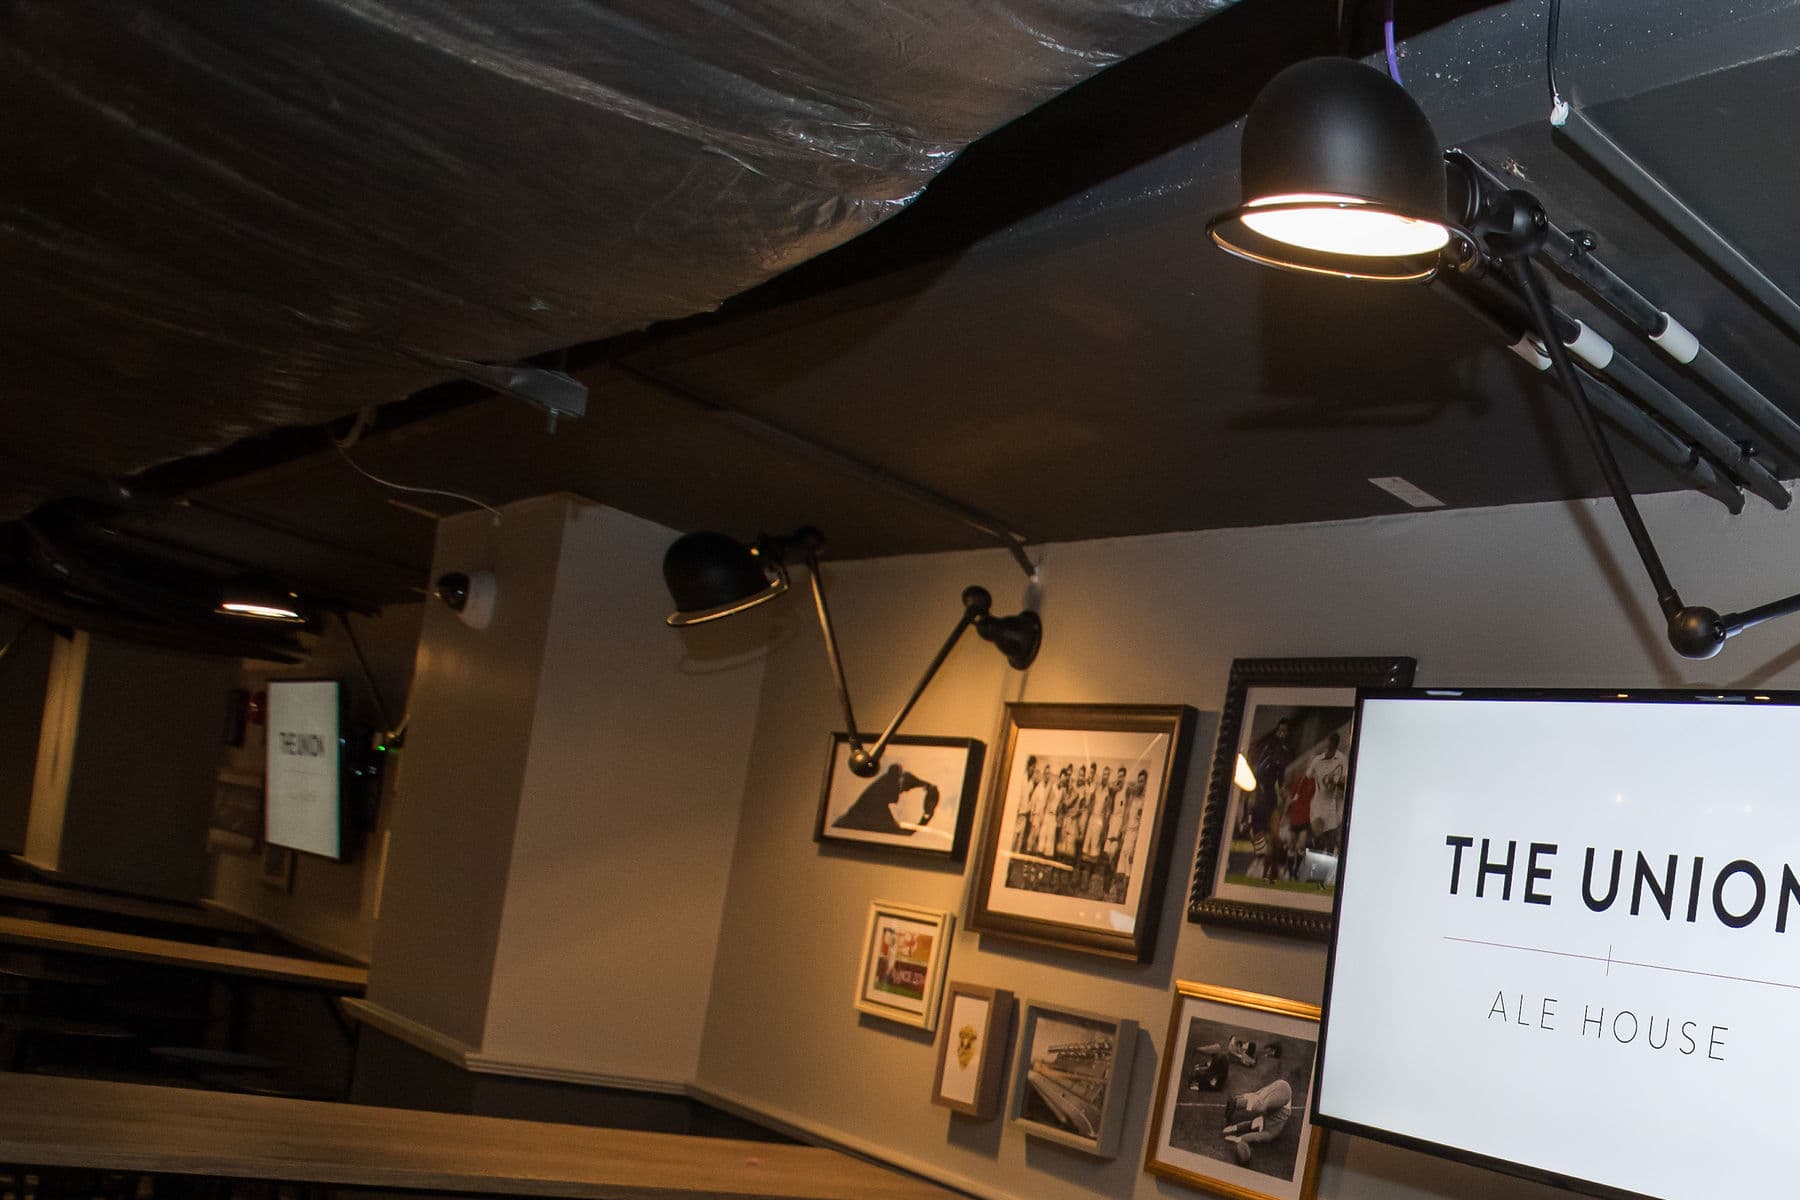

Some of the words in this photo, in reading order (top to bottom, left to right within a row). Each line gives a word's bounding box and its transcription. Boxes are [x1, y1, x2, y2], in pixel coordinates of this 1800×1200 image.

[1446, 835, 1558, 905] THE
[1487, 990, 1558, 1030] ALE
[1582, 1004, 1729, 1061] HOUSE
